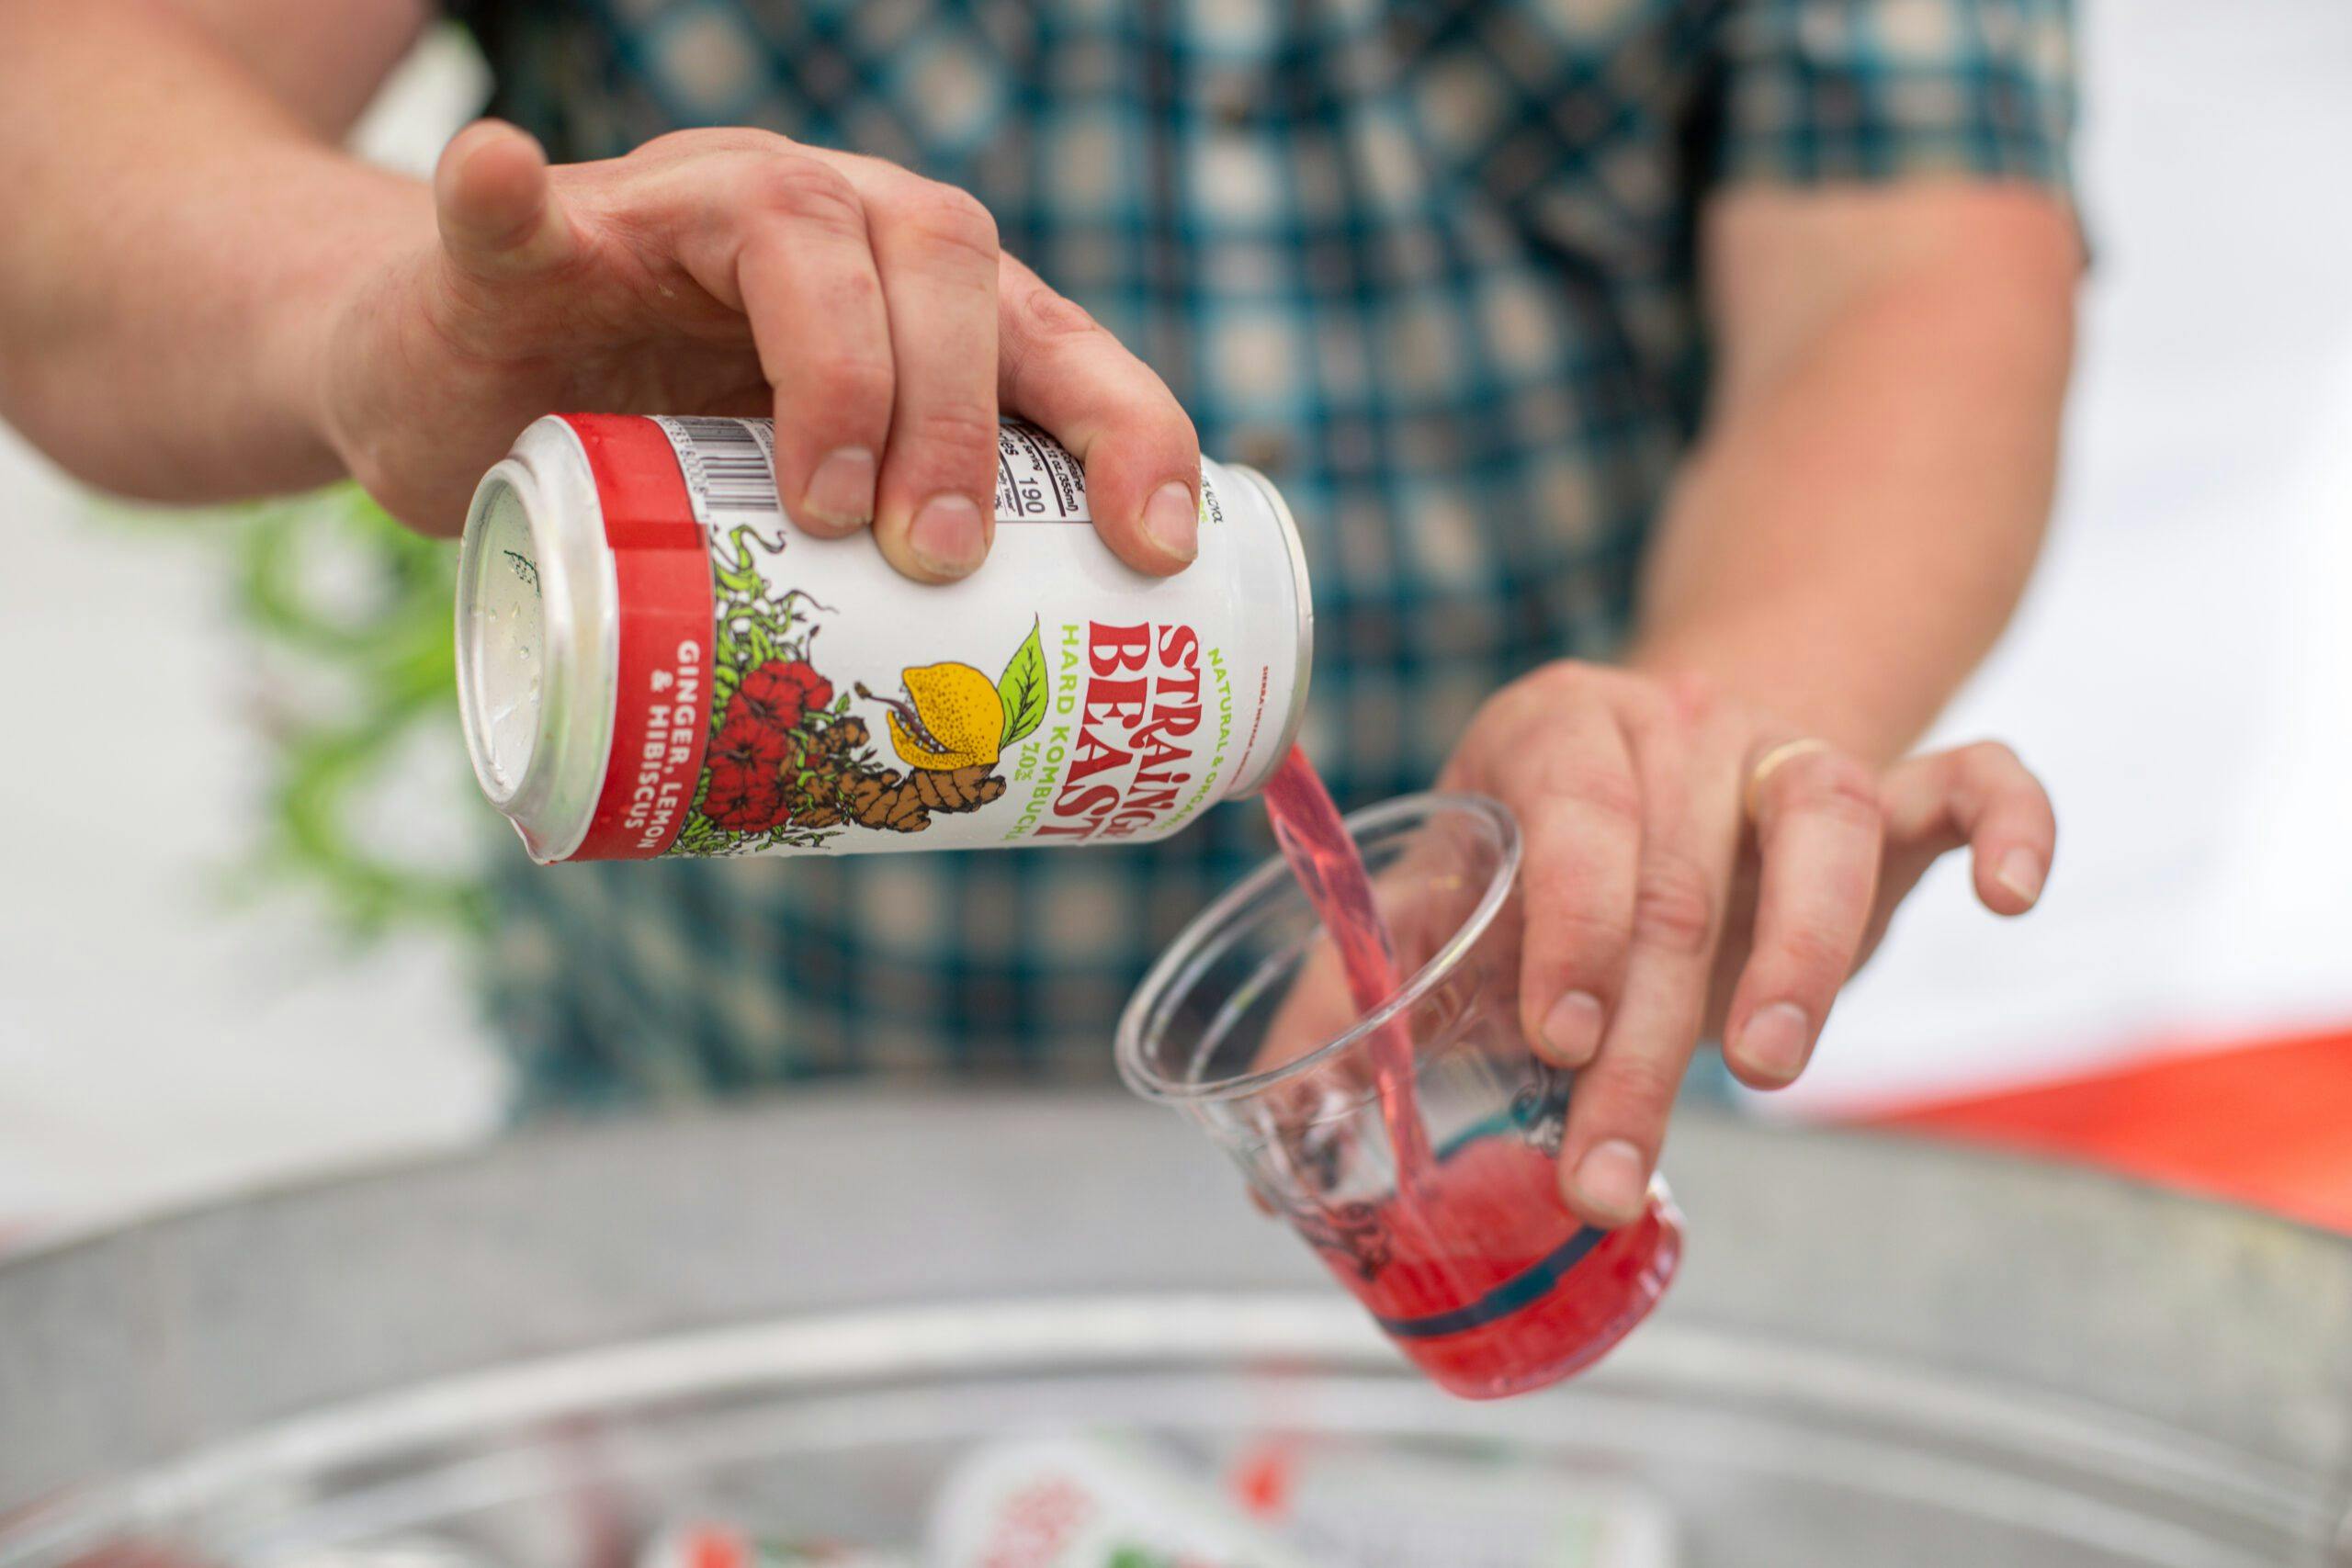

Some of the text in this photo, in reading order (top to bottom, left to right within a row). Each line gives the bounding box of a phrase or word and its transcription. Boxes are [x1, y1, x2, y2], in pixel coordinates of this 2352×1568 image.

[1019, 477, 1046, 513] 190
[625, 670, 673, 829] & HIBISCUS
[637, 639, 700, 849] GINGER, LEMON
[1001, 625, 1080, 840] HARD KOMBUCHA
[1032, 620, 1151, 841] BEAST
[1207, 647, 1233, 752] NATURAL
[1259, 665, 1269, 705] SIERRA
[1211, 755, 1225, 768] &
